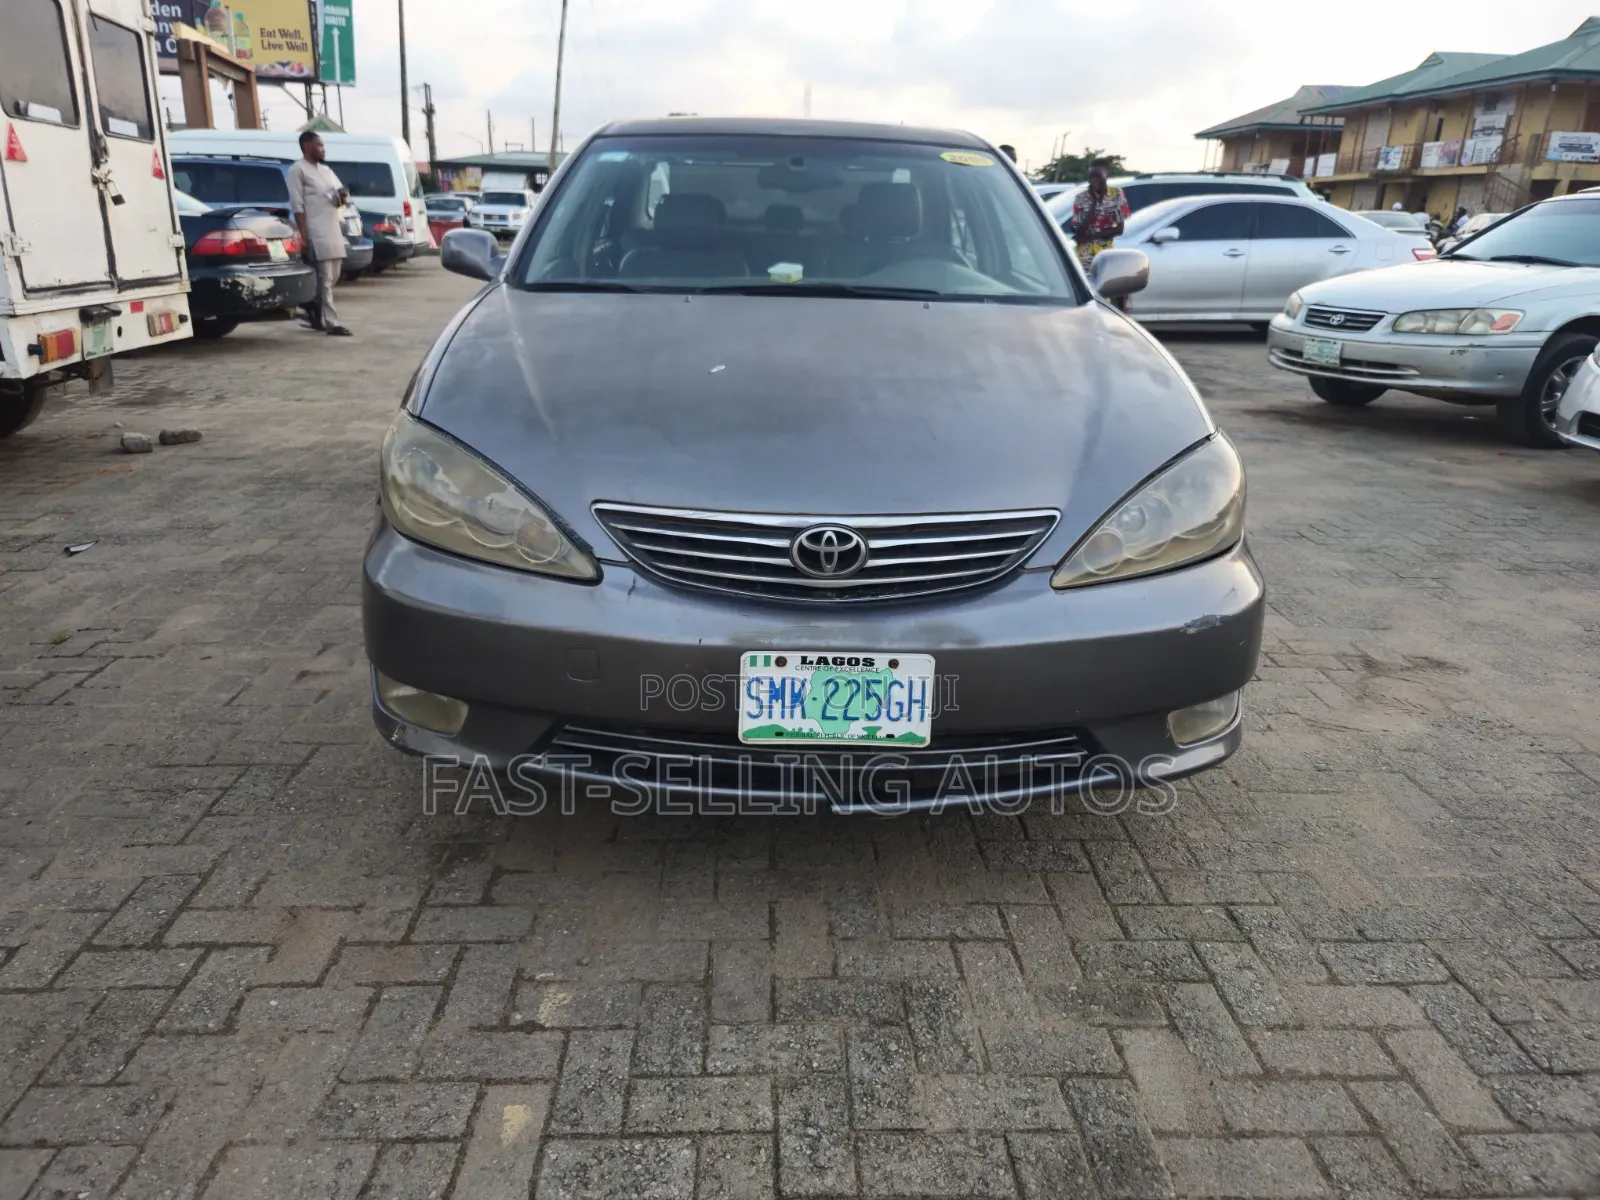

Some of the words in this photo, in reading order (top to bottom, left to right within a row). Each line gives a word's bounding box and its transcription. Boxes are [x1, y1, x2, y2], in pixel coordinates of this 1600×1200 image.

[259, 28, 276, 38] Eat
[278, 29, 305, 40] Well,
[261, 40, 284, 51] Live
[285, 41, 308, 52] Well
[800, 655, 876, 668] LAGOS
[794, 664, 821, 672] CENTRE
[822, 665, 834, 673] OF
[834, 665, 881, 674] EXCELLENCE
